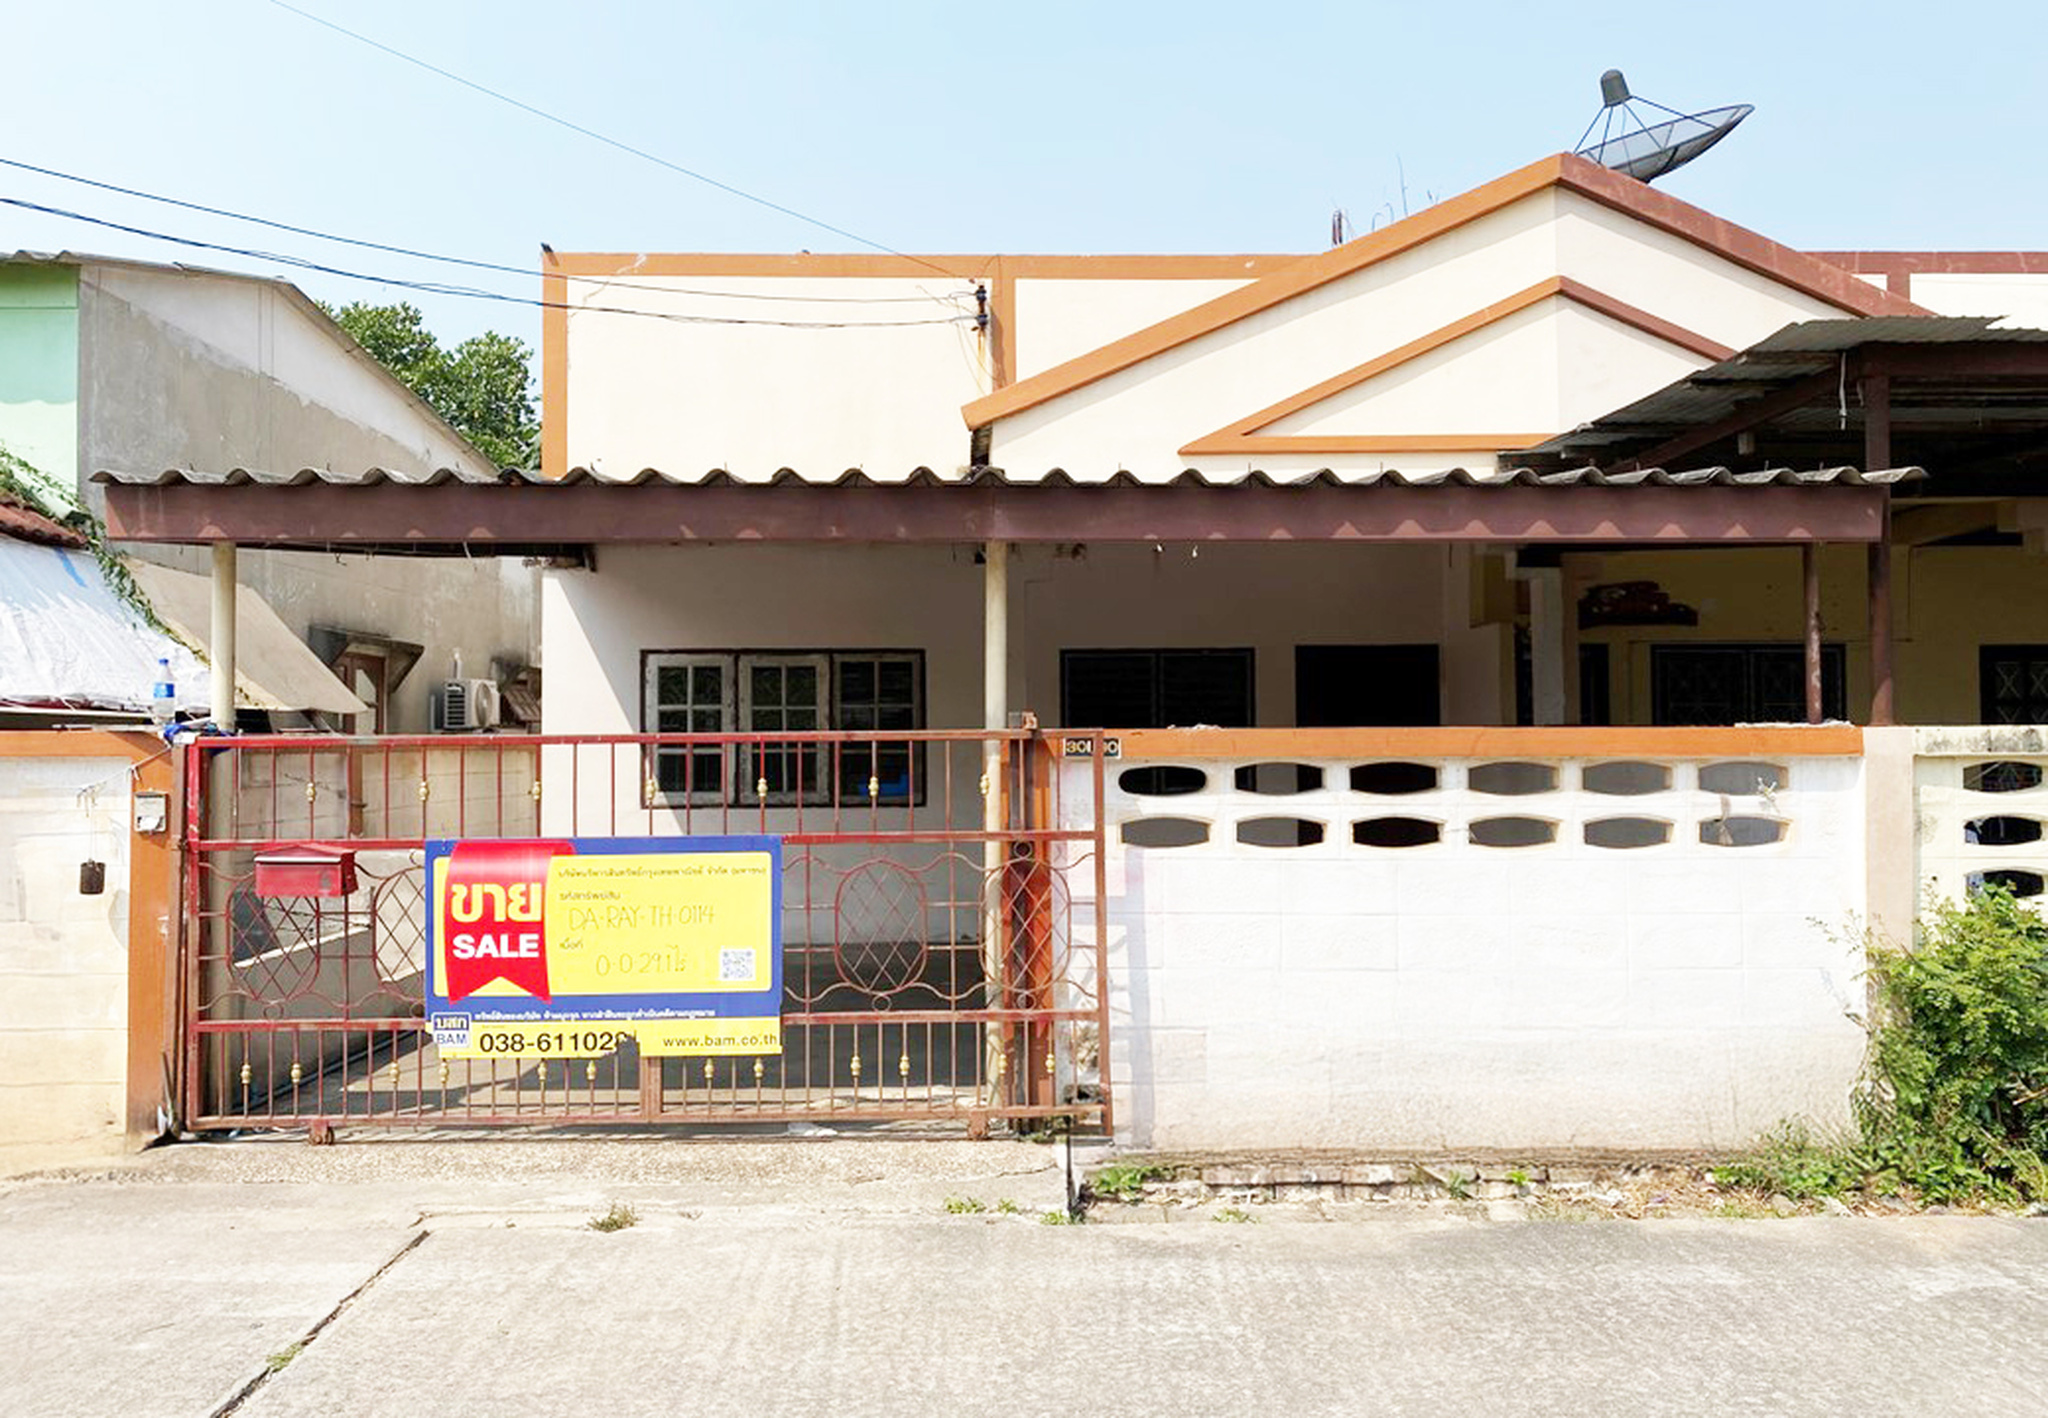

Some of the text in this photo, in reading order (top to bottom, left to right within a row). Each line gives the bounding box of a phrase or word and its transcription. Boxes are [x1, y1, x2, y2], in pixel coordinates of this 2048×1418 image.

[451, 882, 542, 923] ขาย
[452, 933, 540, 959] SALE
[436, 1033, 468, 1046] BAM
[662, 1033, 778, 1048] www.bam.co.th
